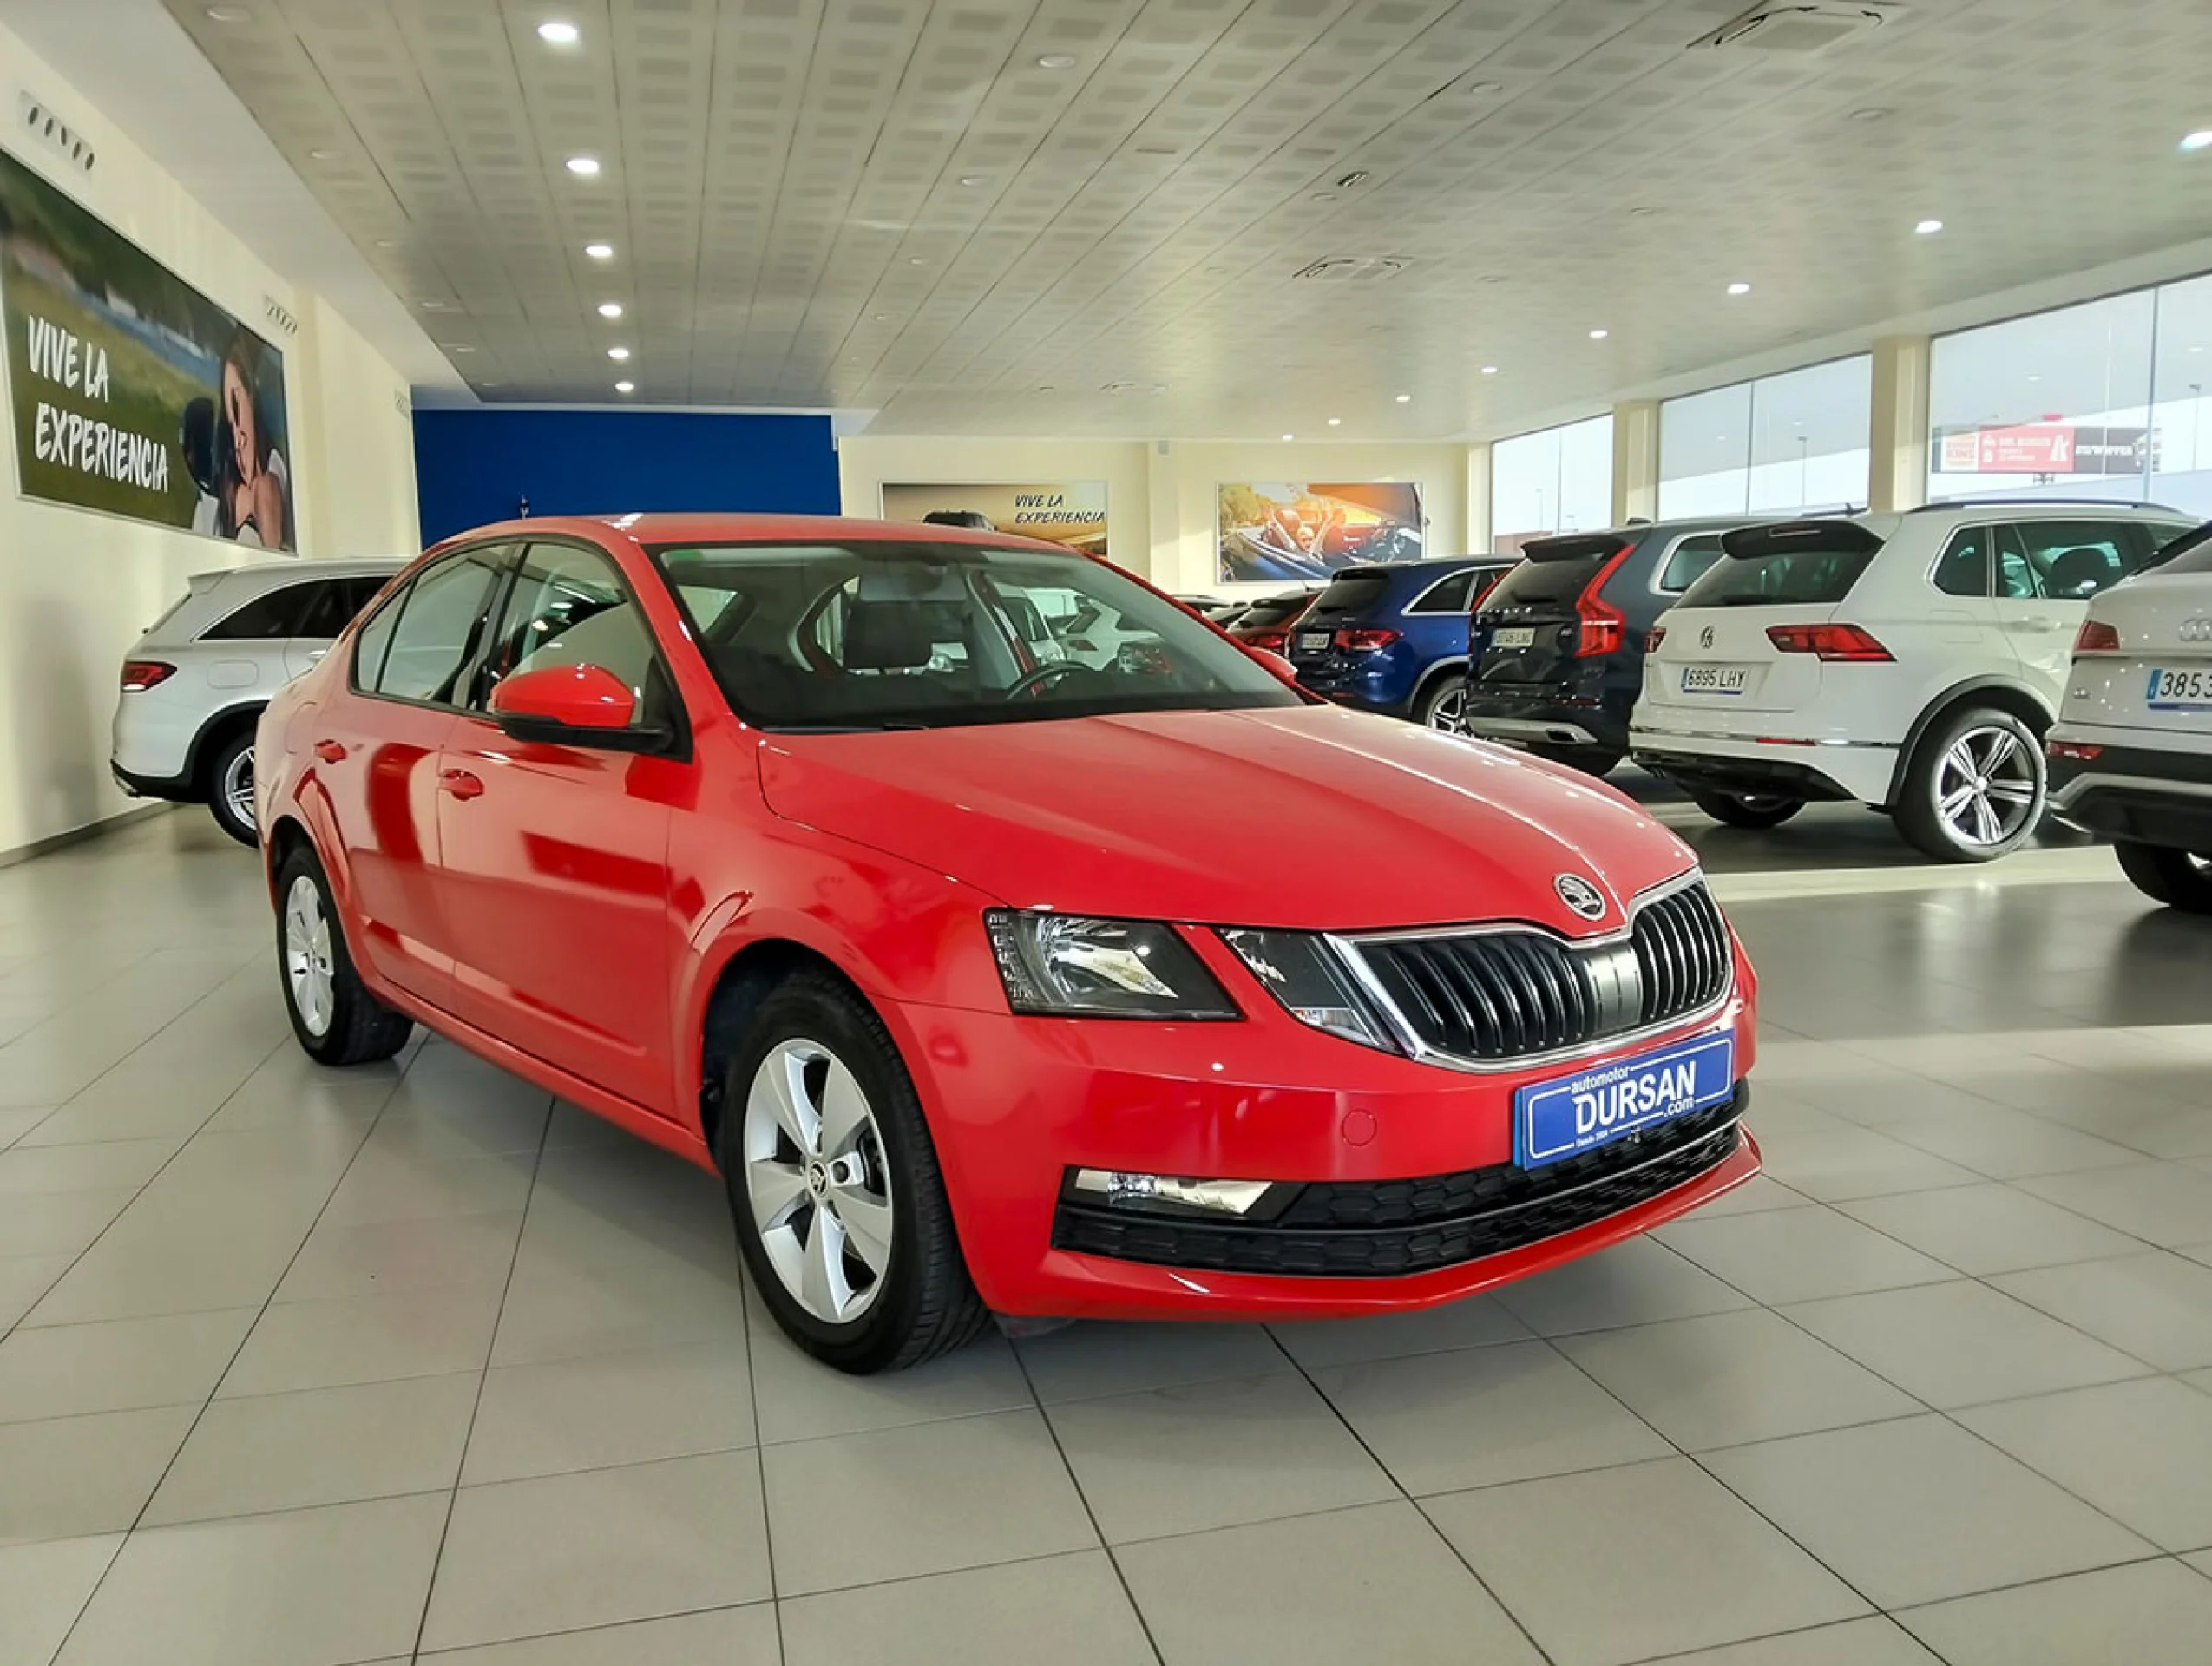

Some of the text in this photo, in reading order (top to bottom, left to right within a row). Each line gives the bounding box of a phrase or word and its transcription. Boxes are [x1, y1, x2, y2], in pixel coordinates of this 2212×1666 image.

[28, 314, 109, 403] VIVE LA
[34, 401, 169, 493] EXPERIENCIA
[1014, 495, 1064, 508] VIVE LA
[1014, 511, 1106, 524] EXPERIENCIA
[1719, 670, 1747, 688] LHY
[1572, 1066, 1631, 1094] automotor
[1572, 1060, 1697, 1136] DURSAN
[1664, 1096, 1696, 1118] .com
